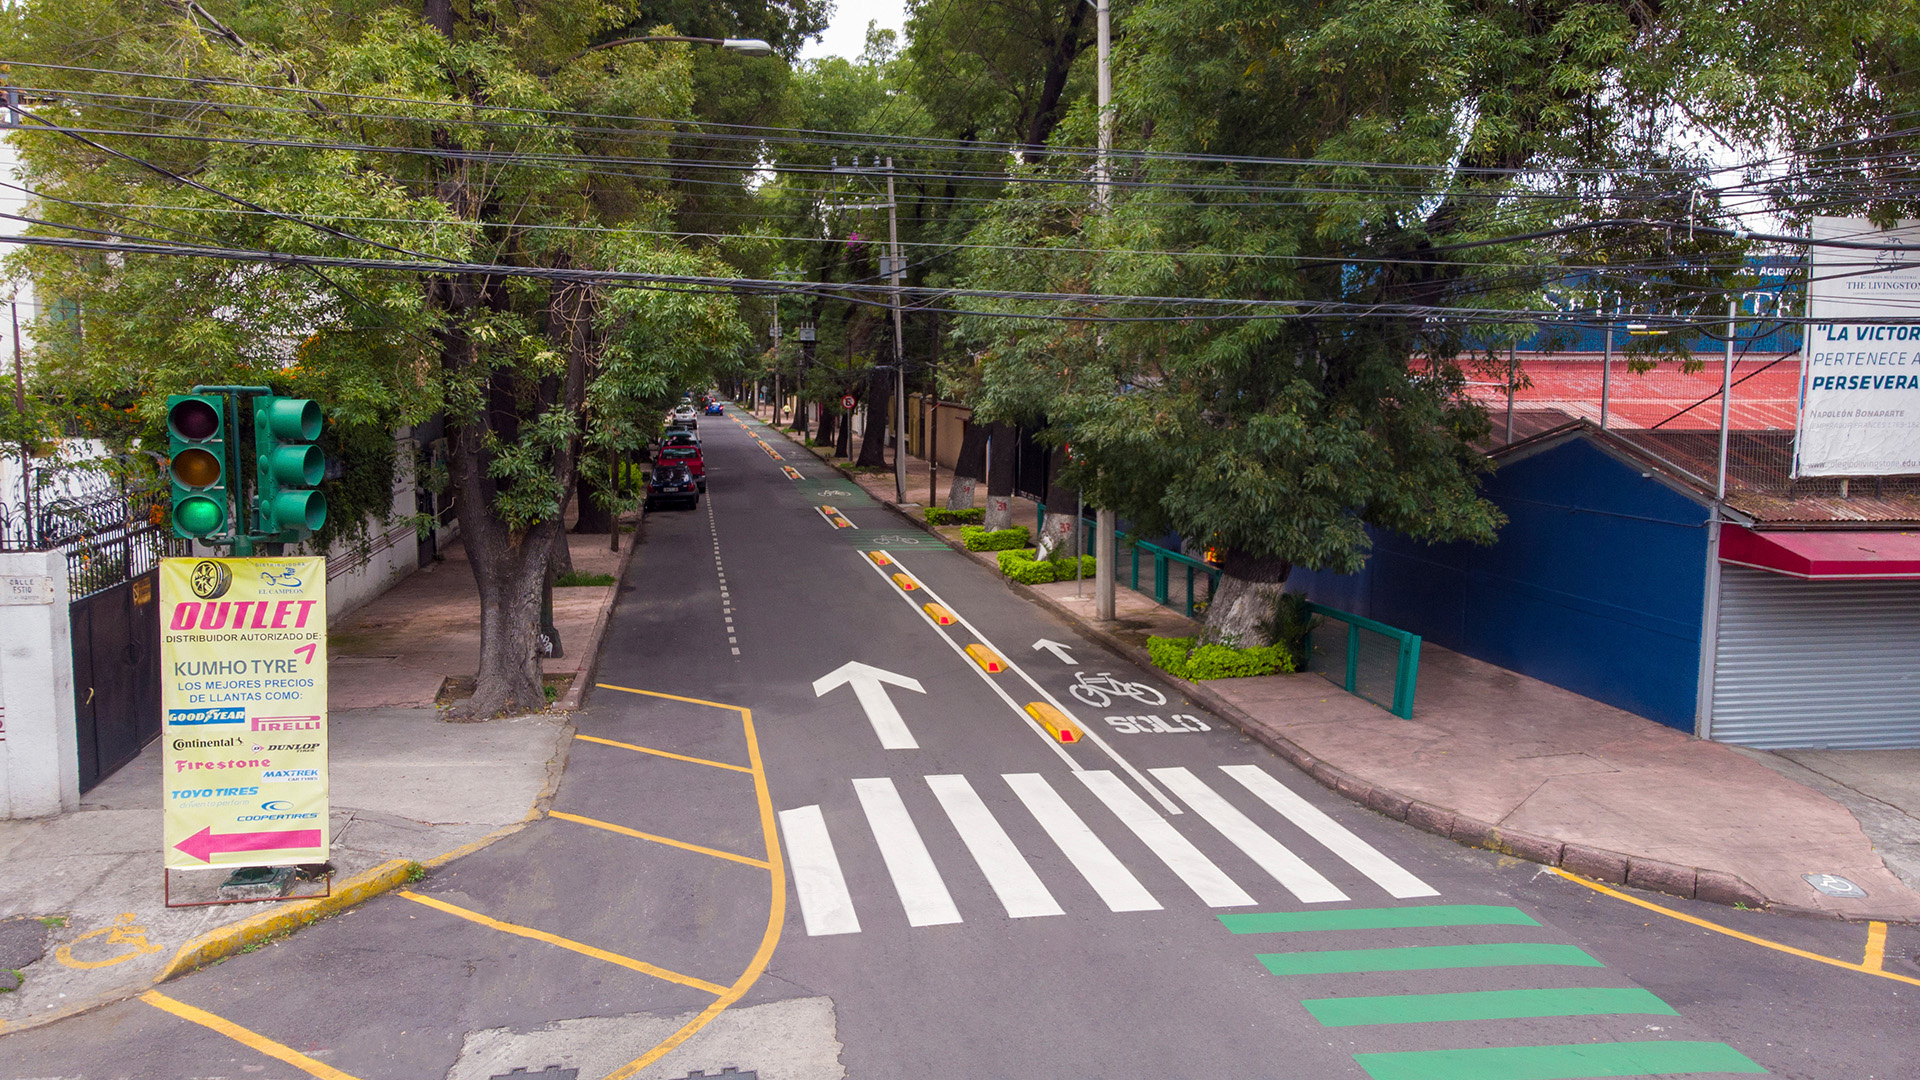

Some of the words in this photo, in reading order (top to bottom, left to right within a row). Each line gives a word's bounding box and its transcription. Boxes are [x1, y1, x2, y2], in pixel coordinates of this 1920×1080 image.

[1814, 352, 1908, 366] PERTENECE
[1812, 376, 1918, 390] PERSEVERA
[170, 600, 316, 630] OUTLET
[175, 660, 247, 676] KUMHO
[251, 660, 297, 673] TYRE
[178, 682, 201, 690] LOS
[205, 681, 261, 689] MEJORES
[265, 679, 314, 687] PRECIOS
[190, 694, 205, 703] DE
[210, 693, 261, 702] LLANTAS
[265, 692, 302, 700] COMO:
[169, 709, 245, 722] GOODYEAR
[251, 716, 320, 731] PIRELLI
[1104, 715, 1211, 734] SOLO
[173, 738, 234, 751] Continental
[267, 743, 320, 751] DUNLOP
[175, 758, 271, 773] Firestone
[263, 769, 318, 778] MAXTREK
[172, 789, 213, 799] TOYO
[216, 786, 259, 796] TIRES
